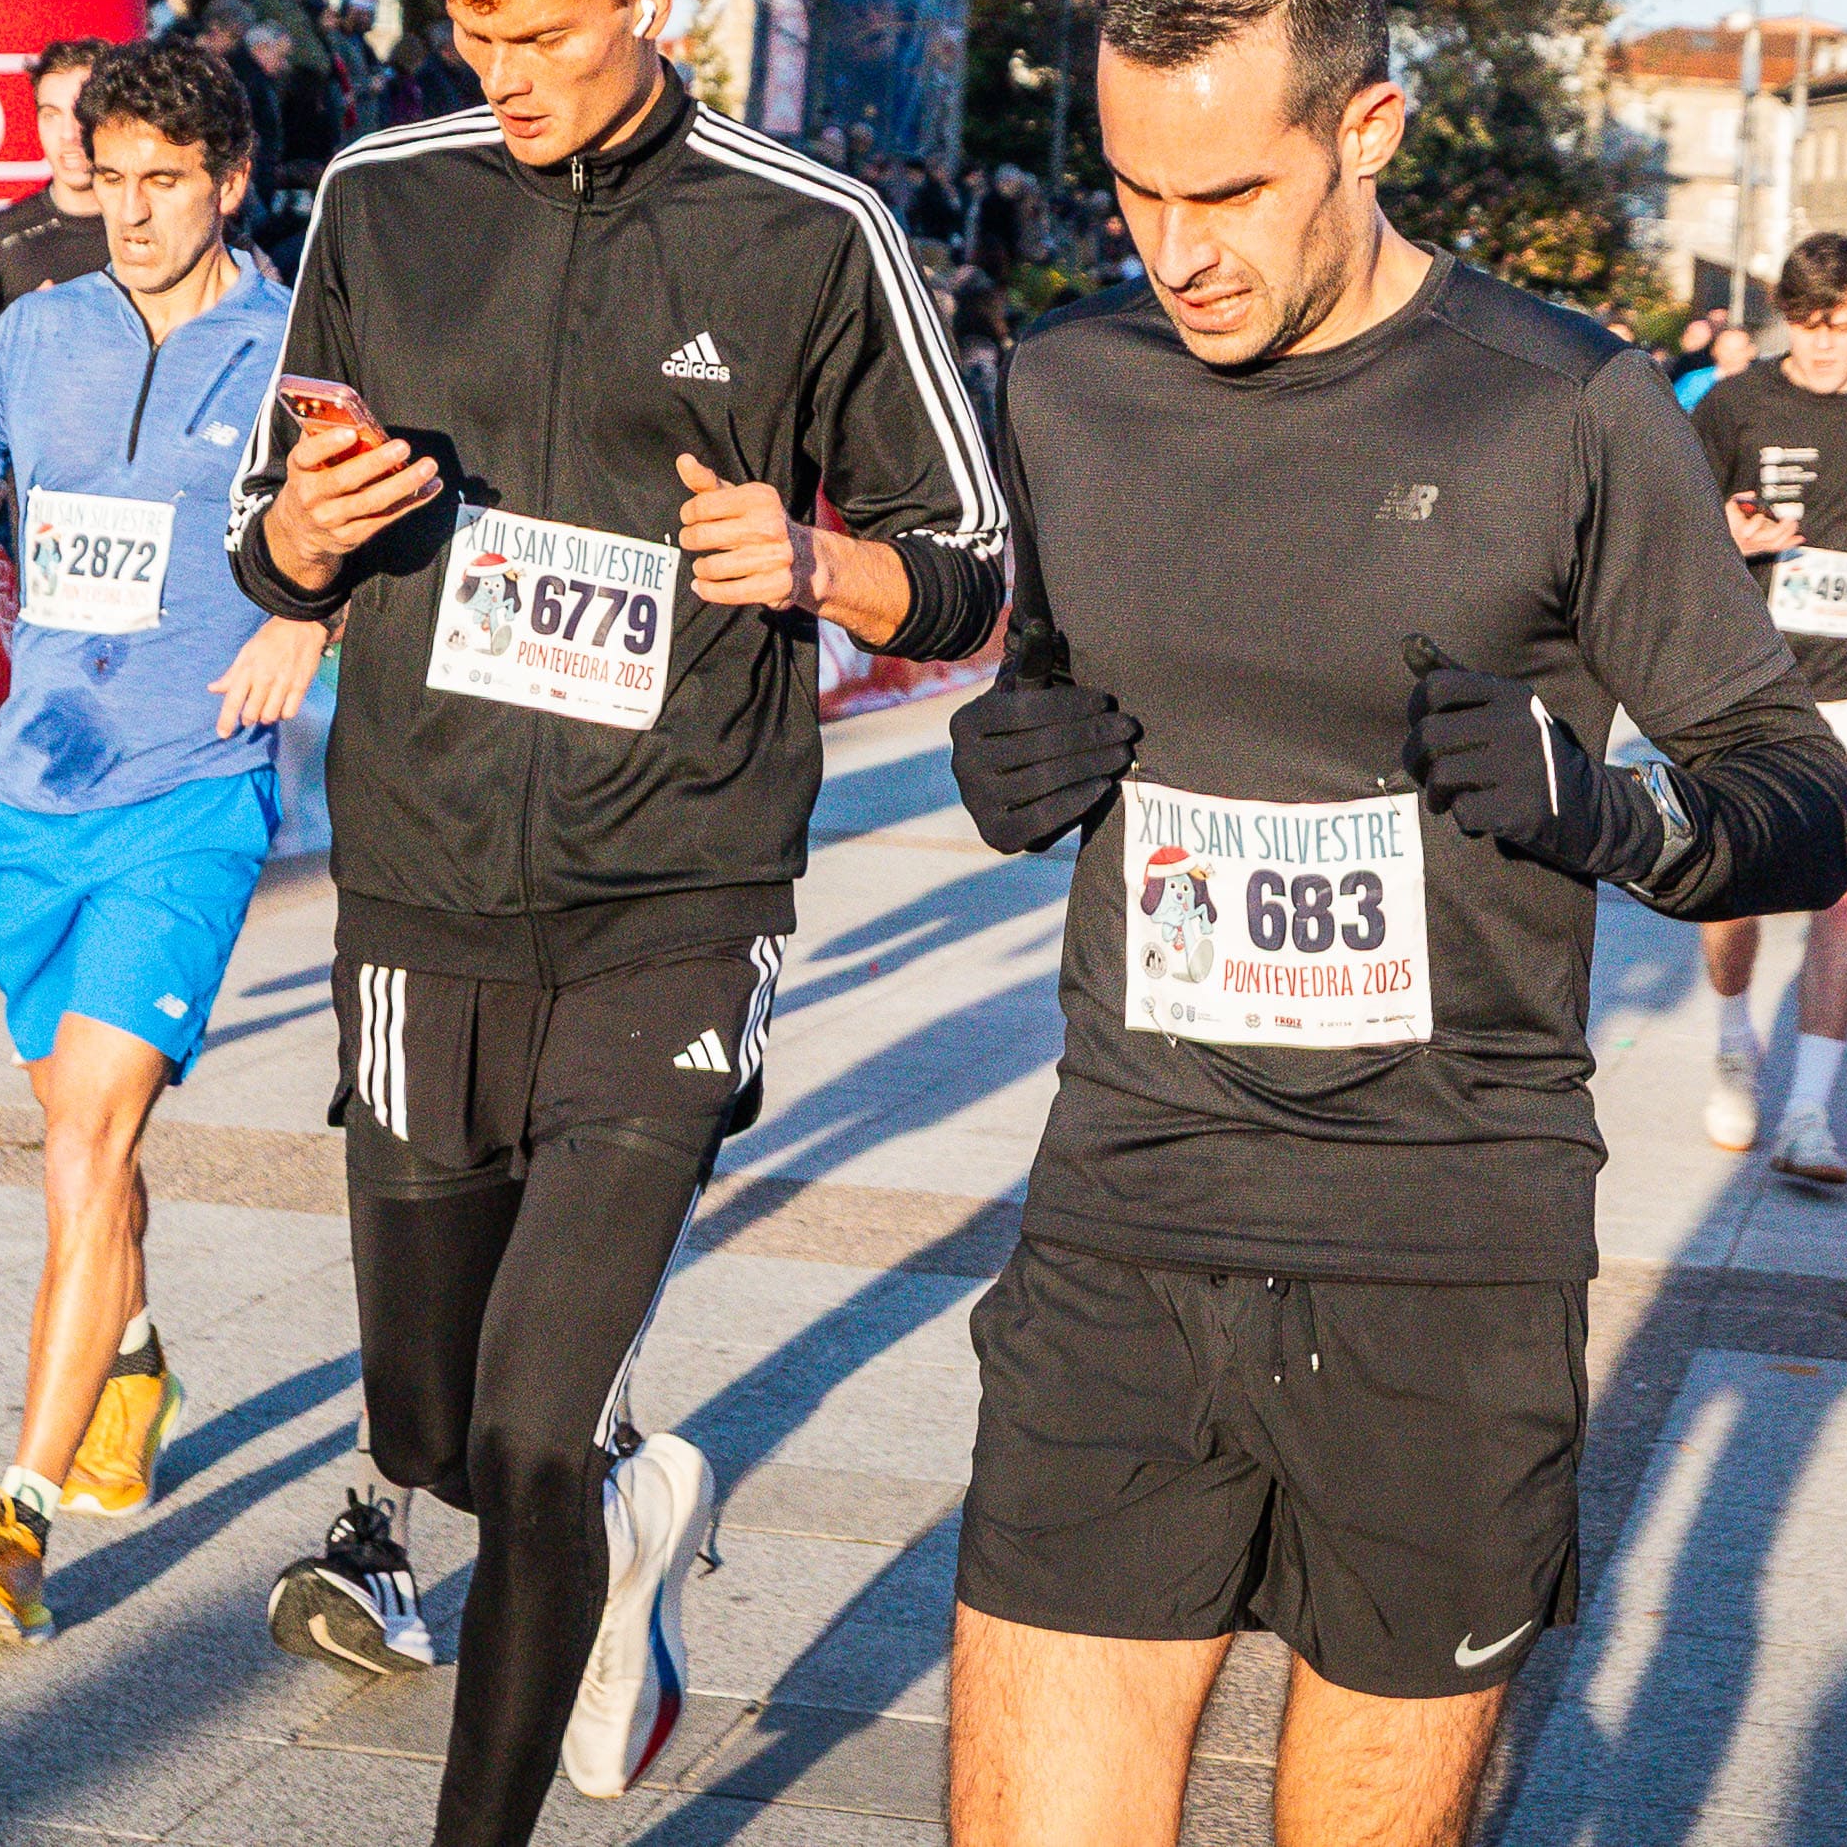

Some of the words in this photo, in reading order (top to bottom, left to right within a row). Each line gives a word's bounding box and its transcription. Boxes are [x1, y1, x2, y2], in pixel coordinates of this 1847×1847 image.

[661, 359, 730, 382] adidas
[68, 534, 156, 582] 2872
[466, 520, 506, 552] XLII
[514, 527, 556, 567] SAN
[566, 536, 667, 590] SILVESTRE
[531, 575, 657, 654] 6779
[517, 640, 609, 683] PONTEVEDRA
[616, 661, 654, 691] 2025
[1139, 799, 1183, 847] XLII
[1191, 807, 1245, 858] SAN
[1254, 810, 1405, 864] SILVESTRE
[1246, 868, 1386, 953] 683
[1224, 959, 1354, 998] PONTEVEDRA
[1362, 958, 1413, 995] 2025
